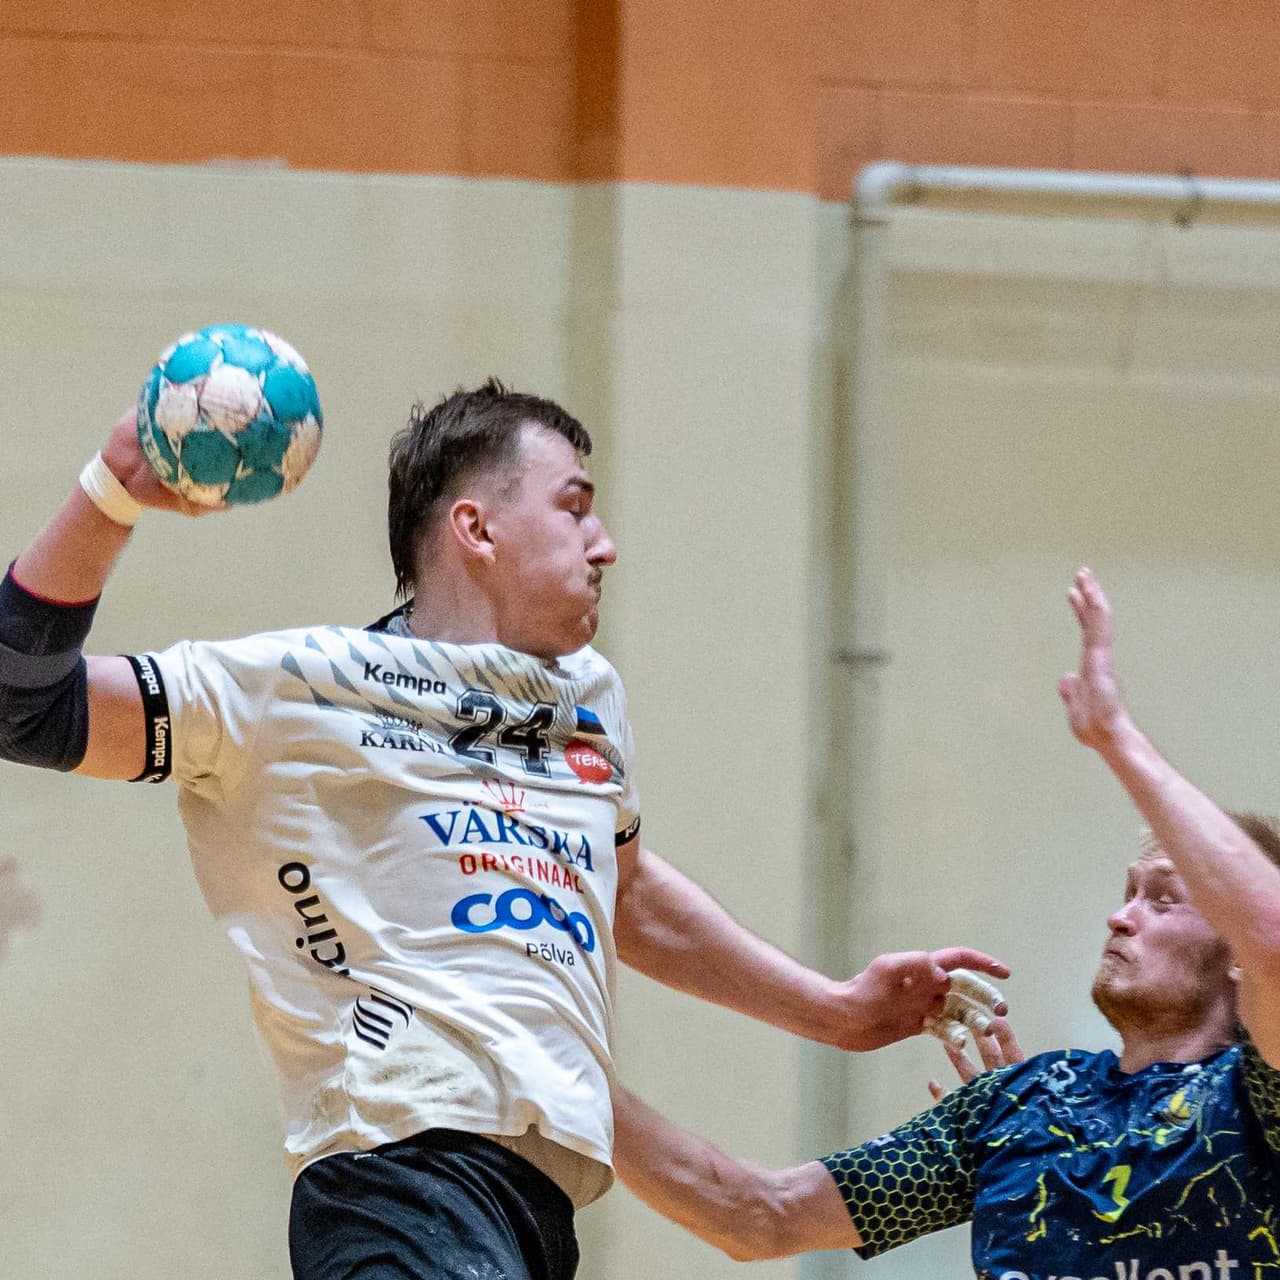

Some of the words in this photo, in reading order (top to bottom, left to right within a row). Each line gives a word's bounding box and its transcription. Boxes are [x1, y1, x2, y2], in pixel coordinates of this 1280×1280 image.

[363, 661, 447, 696] Kempa
[152, 716, 169, 767] Kempa
[448, 688, 558, 778] 24
[459, 852, 585, 895] ORIGINAAL
[278, 861, 350, 977] cino
[451, 887, 596, 954] coop
[525, 942, 575, 967] Põlva
